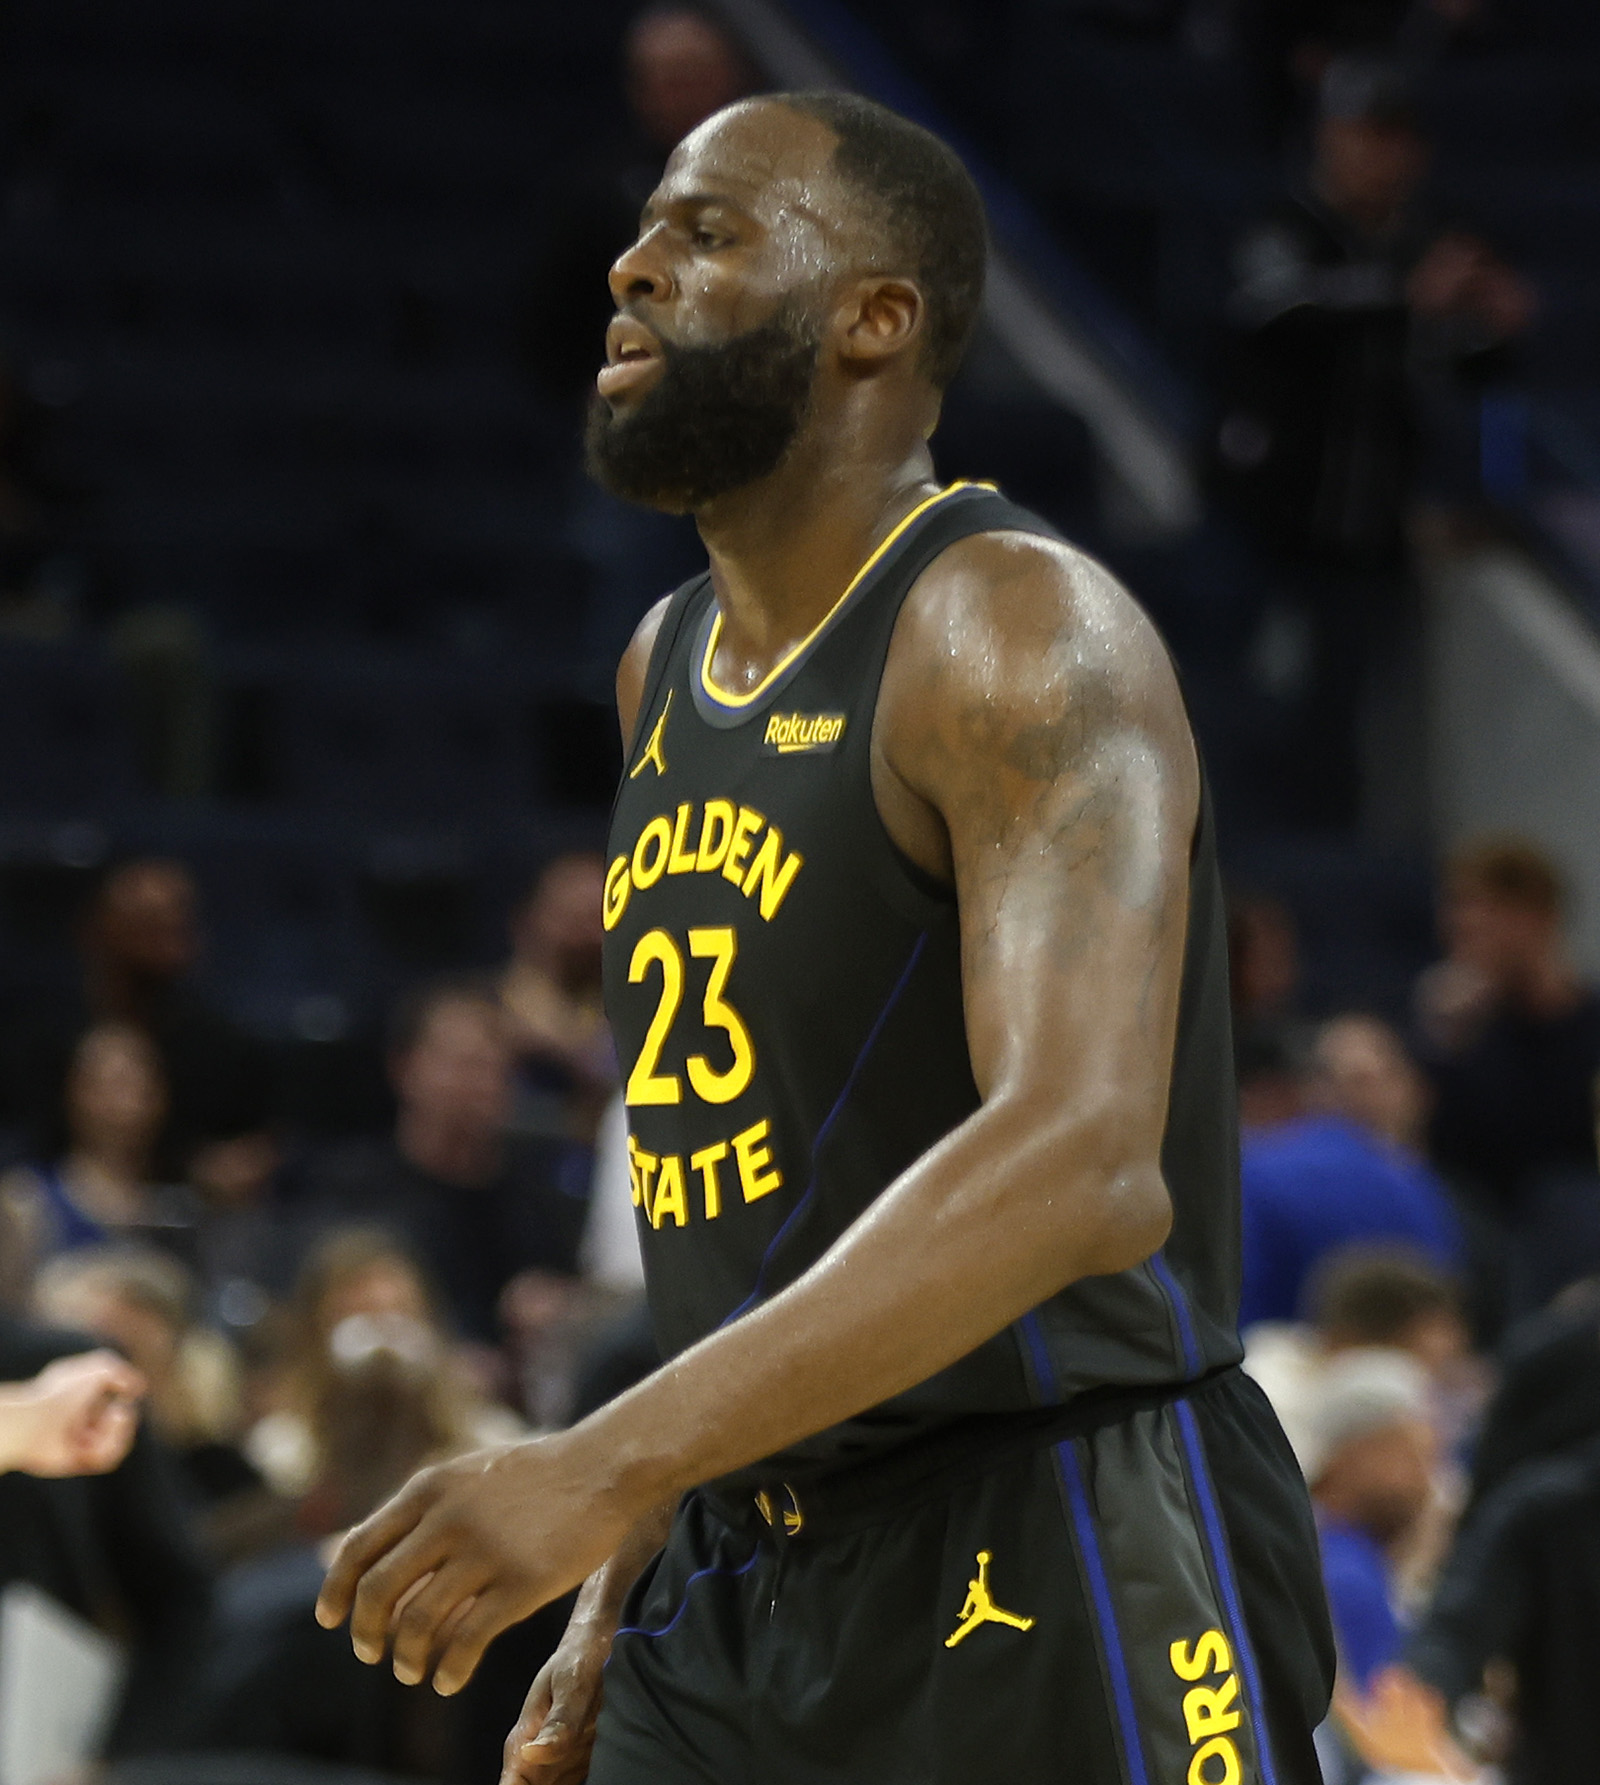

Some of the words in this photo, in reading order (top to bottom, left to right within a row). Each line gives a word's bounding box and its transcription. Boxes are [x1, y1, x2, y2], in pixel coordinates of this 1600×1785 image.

[763, 712, 846, 745] Rakuten
[602, 797, 803, 932] GOLDEN
[625, 926, 756, 1106] 23
